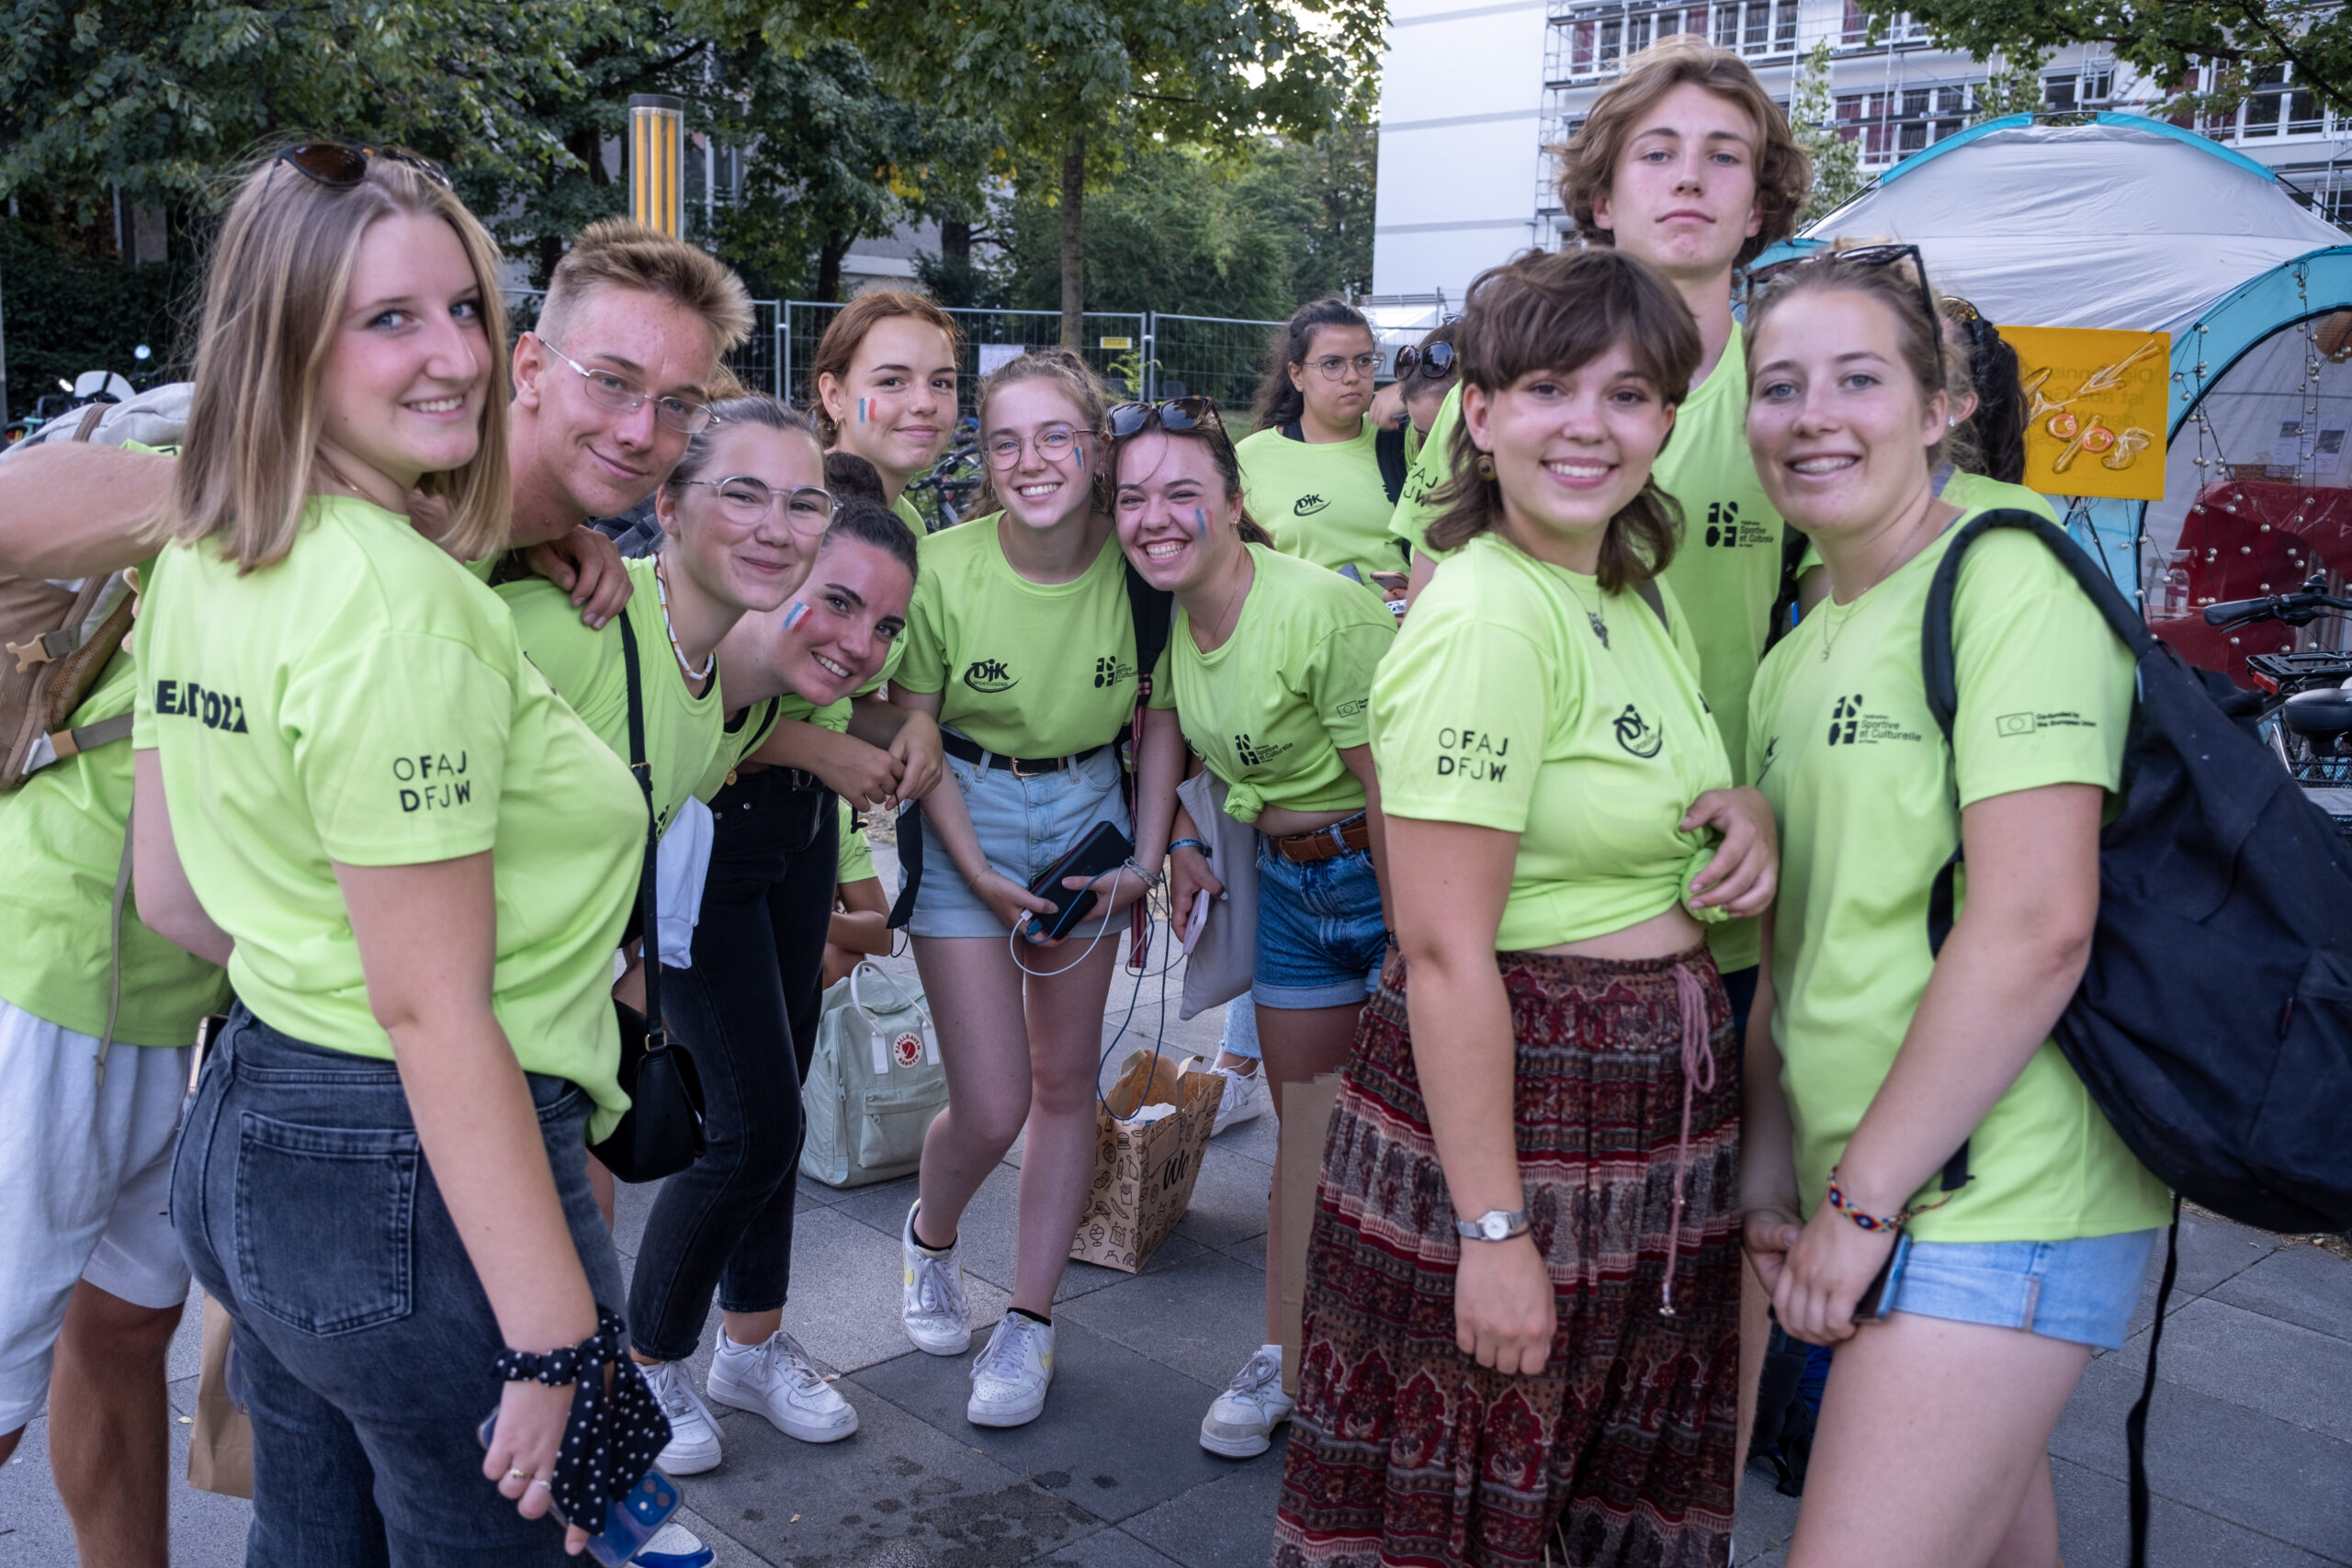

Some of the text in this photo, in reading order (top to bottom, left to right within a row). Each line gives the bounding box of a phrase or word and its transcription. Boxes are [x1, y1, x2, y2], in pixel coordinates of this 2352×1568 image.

[1860, 719, 1901, 730] Sportive
[1871, 729, 1922, 742] Culturelle
[1438, 728, 1509, 757] OFAJ
[392, 750, 467, 782] OFAJ
[1437, 756, 1508, 783] DFJW
[399, 779, 470, 813] DFJW
